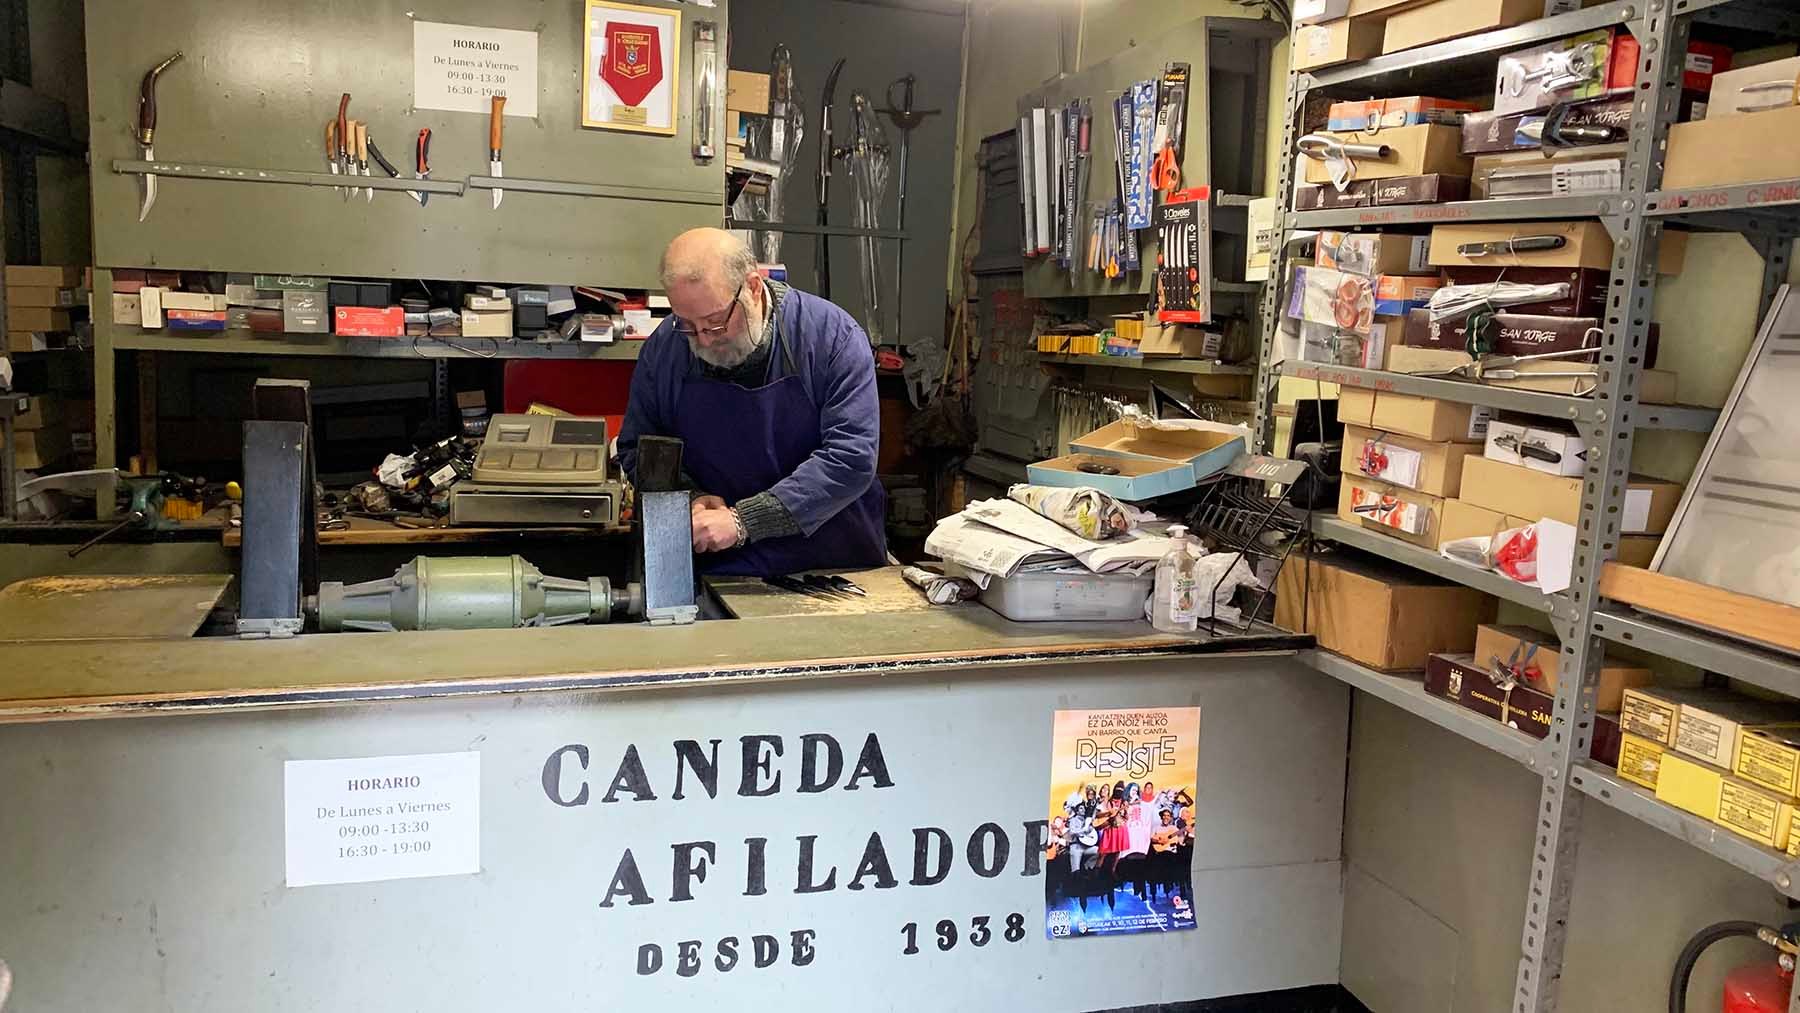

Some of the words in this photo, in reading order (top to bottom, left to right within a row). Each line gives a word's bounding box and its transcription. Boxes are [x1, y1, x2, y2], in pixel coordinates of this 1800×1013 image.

[453, 39, 500, 52] HORARIO
[433, 55, 446, 65] De
[448, 57, 475, 67] Lunes
[484, 60, 519, 71] Viernes
[447, 71, 474, 80] 09:00
[447, 85, 472, 95] 16:30
[482, 87, 506, 97] 19:00
[1164, 209, 1168, 218] 3
[1169, 207, 1190, 218] Claveles
[1500, 329, 1521, 339] SAN
[1524, 330, 1557, 343] JORGE
[1088, 719, 1099, 728] EZ
[1101, 719, 1114, 728] DA
[1116, 718, 1140, 727] INOIZ
[1142, 717, 1168, 726] HILKO
[1531, 710, 1552, 726] SAN
[1076, 735, 1177, 779] RESISTE
[542, 732, 895, 807] CANEDA
[348, 775, 421, 791] HORARIO
[317, 807, 336, 819] De
[340, 804, 382, 818] Lunes
[386, 806, 394, 815] a
[397, 801, 452, 814] Viernes
[338, 824, 380, 838] 09:00
[338, 844, 378, 858] 16:30
[393, 841, 431, 855] 19:00
[637, 928, 816, 978] DESDE
[901, 913, 1026, 955] 1938
